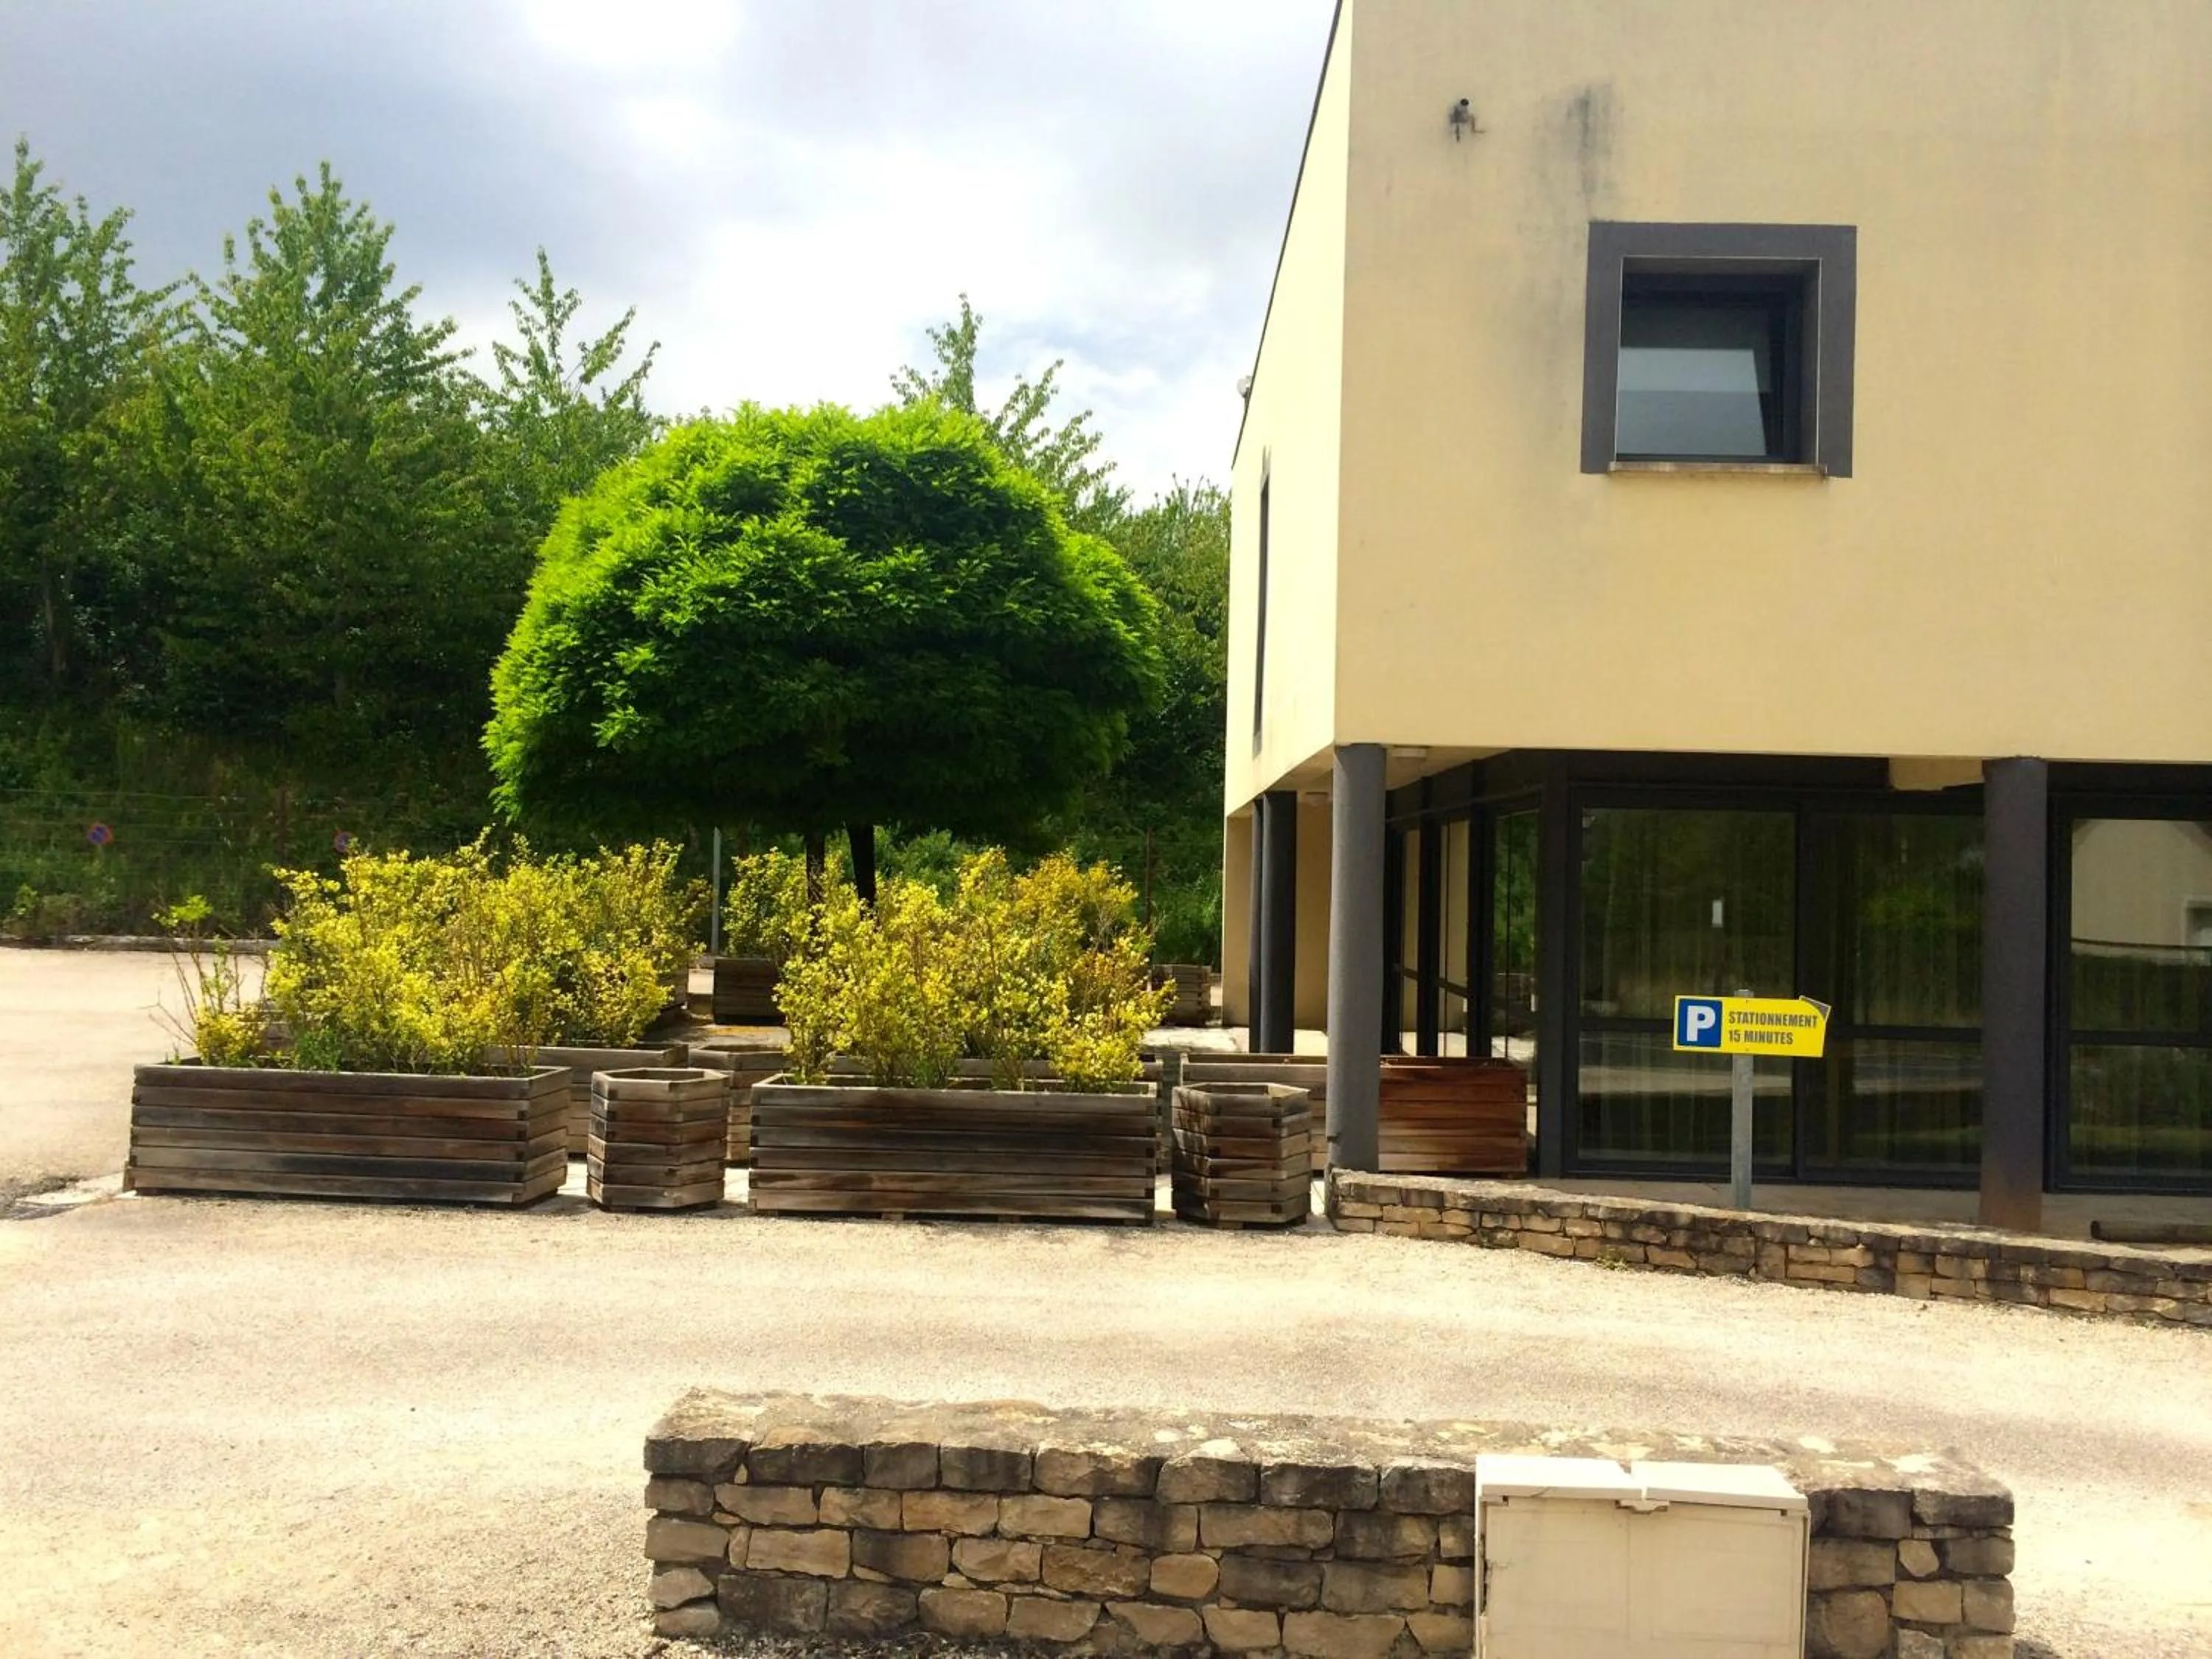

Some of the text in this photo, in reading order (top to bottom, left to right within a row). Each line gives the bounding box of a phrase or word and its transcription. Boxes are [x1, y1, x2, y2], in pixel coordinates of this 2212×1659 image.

[1686, 1005, 1716, 1042] P
[1728, 1011, 1818, 1029] STATIONNEMENT
[1728, 1030, 1794, 1045] 15 MINUTES
